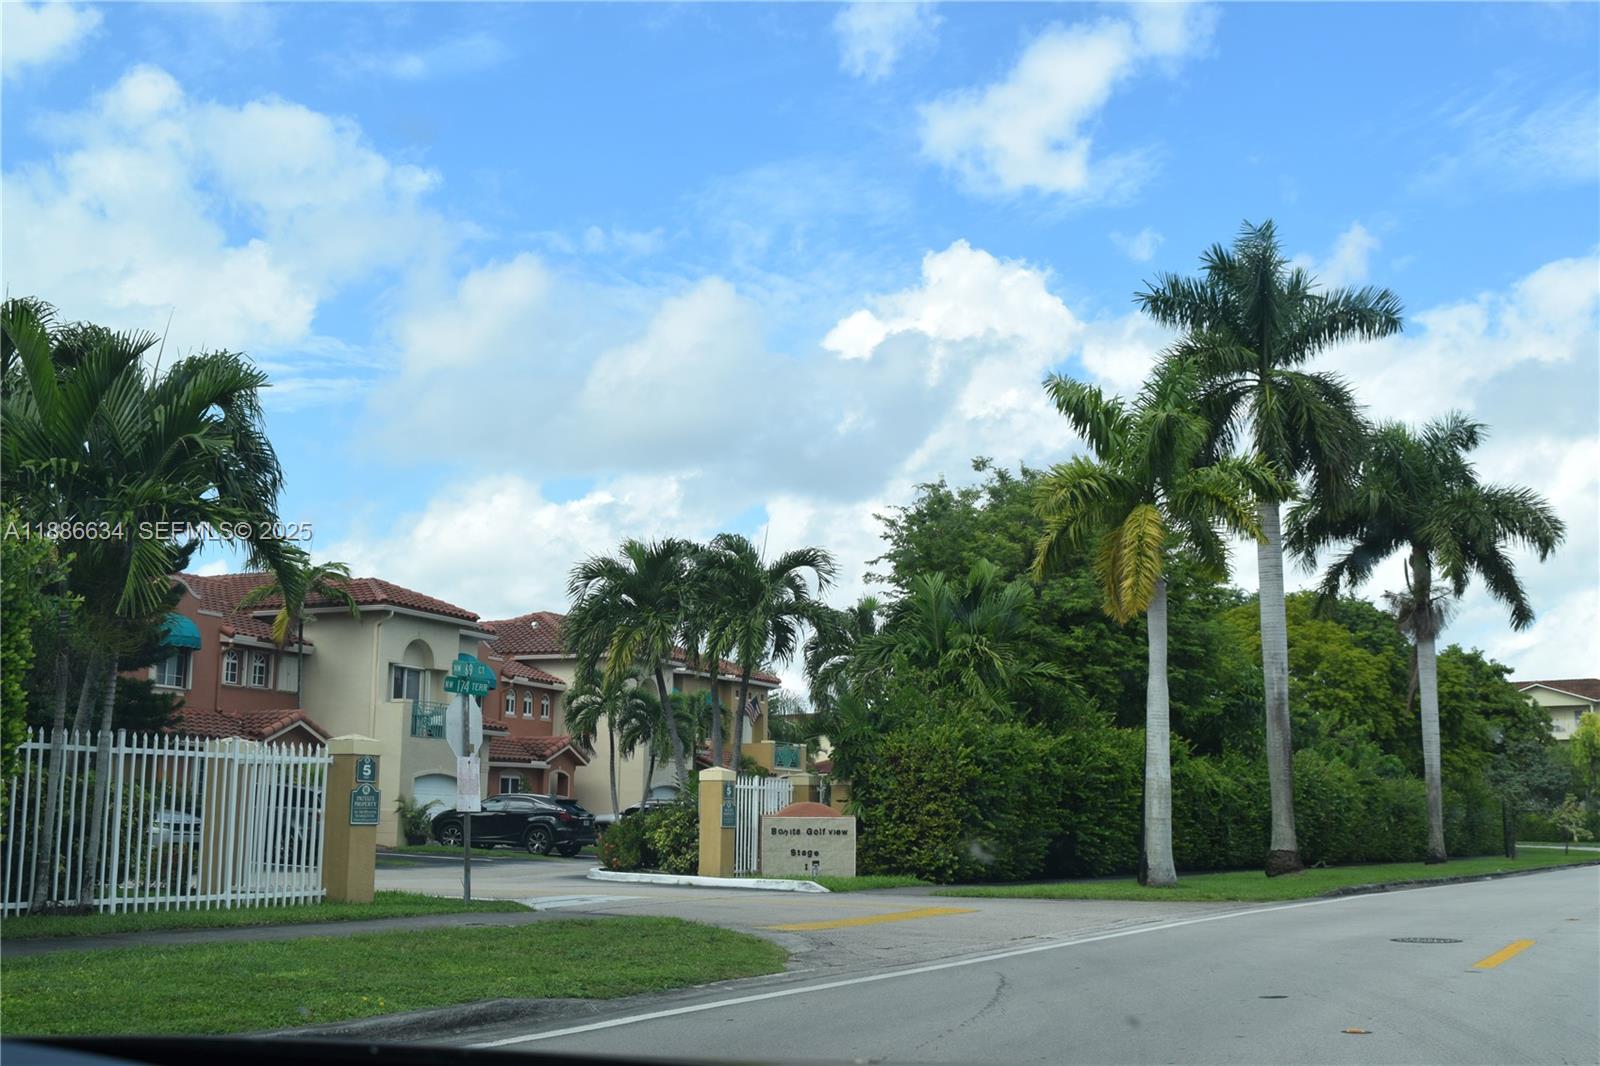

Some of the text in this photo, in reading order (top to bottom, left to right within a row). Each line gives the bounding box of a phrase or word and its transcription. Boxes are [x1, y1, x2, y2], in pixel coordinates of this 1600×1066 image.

[445, 680, 488, 692] NW 174 TERR
[362, 764, 372, 776] 5
[726, 786, 732, 795] 5
[806, 827, 826, 836] Golf
[790, 848, 820, 858] Stage
